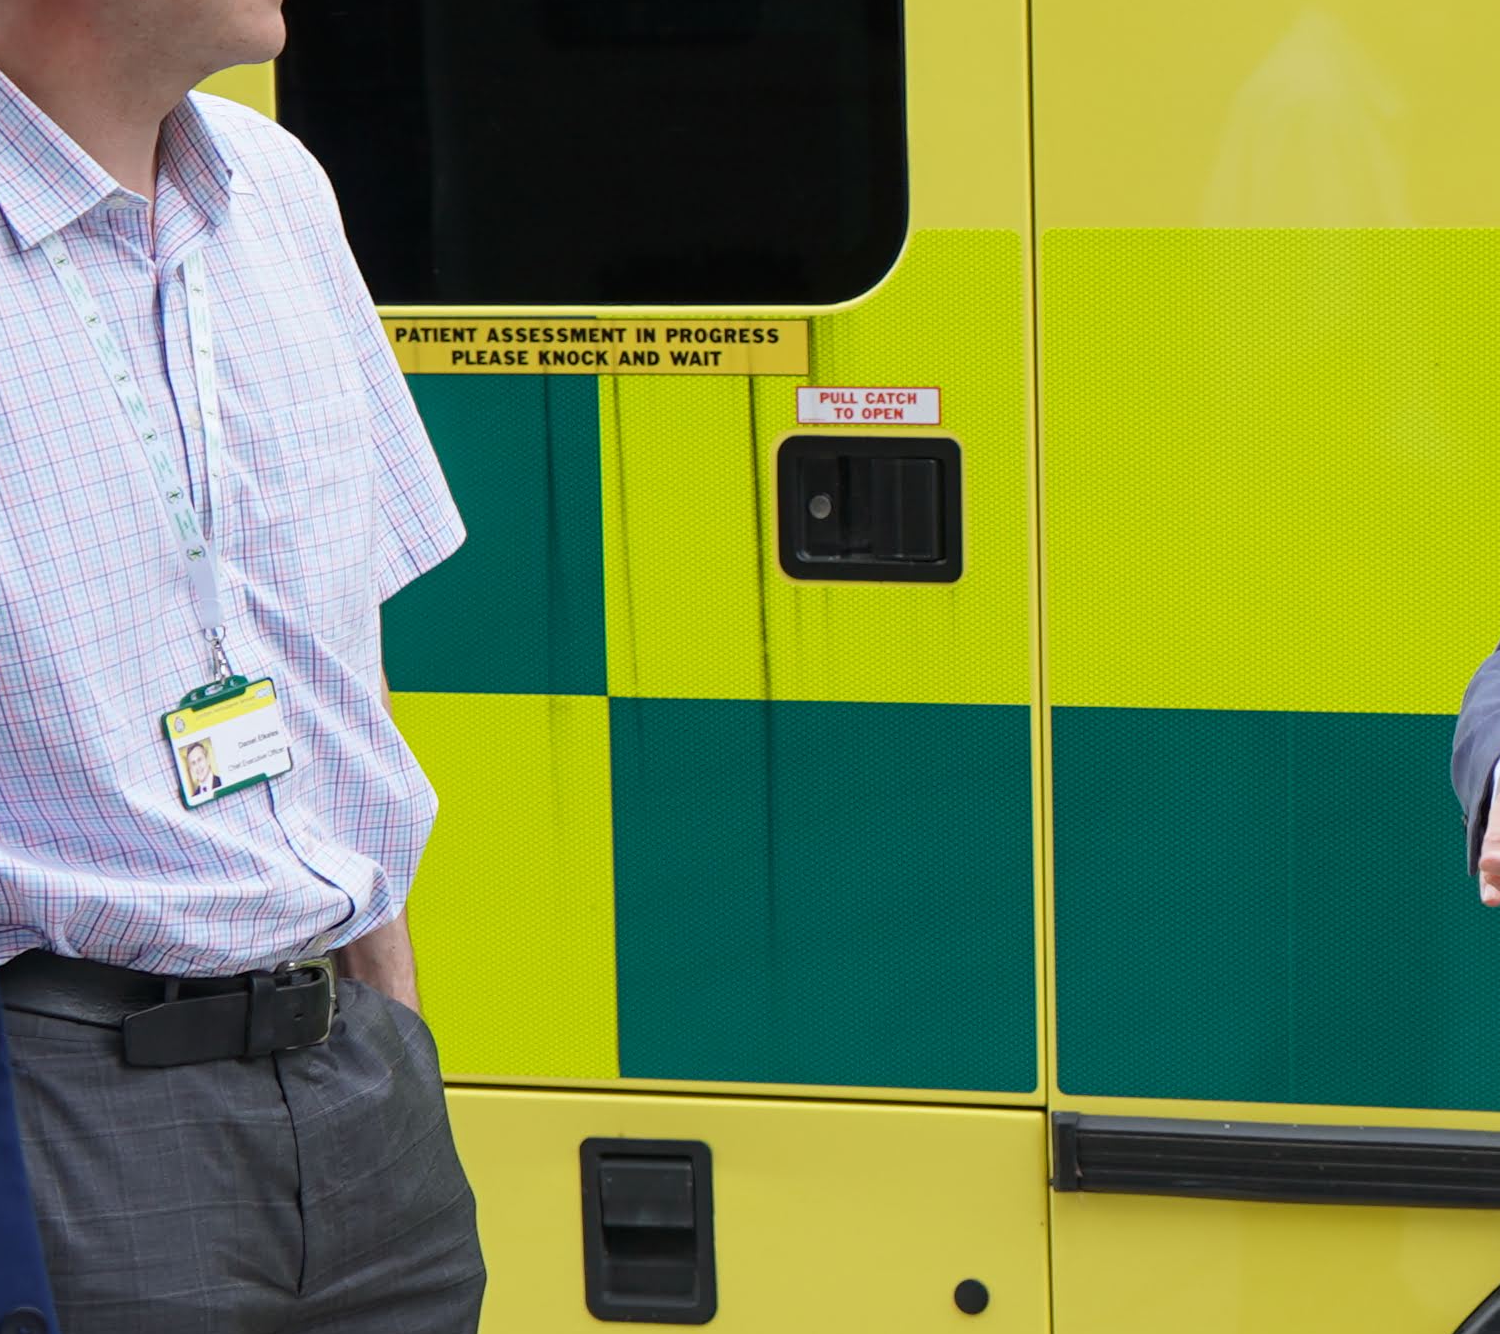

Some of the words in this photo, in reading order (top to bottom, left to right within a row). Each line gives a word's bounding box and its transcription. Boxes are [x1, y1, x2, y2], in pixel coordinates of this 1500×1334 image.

[394, 327, 479, 343] PATIENT
[486, 327, 627, 343] ASSESSMENT
[636, 328, 656, 343] IN
[665, 328, 780, 344] PROGRESS
[451, 350, 528, 366] PLEASE
[538, 350, 609, 366] KNOCK
[618, 351, 660, 367] AND
[669, 351, 722, 367] WAIT
[819, 392, 858, 404] PULL
[865, 392, 917, 405] CATCH
[834, 408, 854, 420] TO
[862, 408, 904, 420] OPEN
